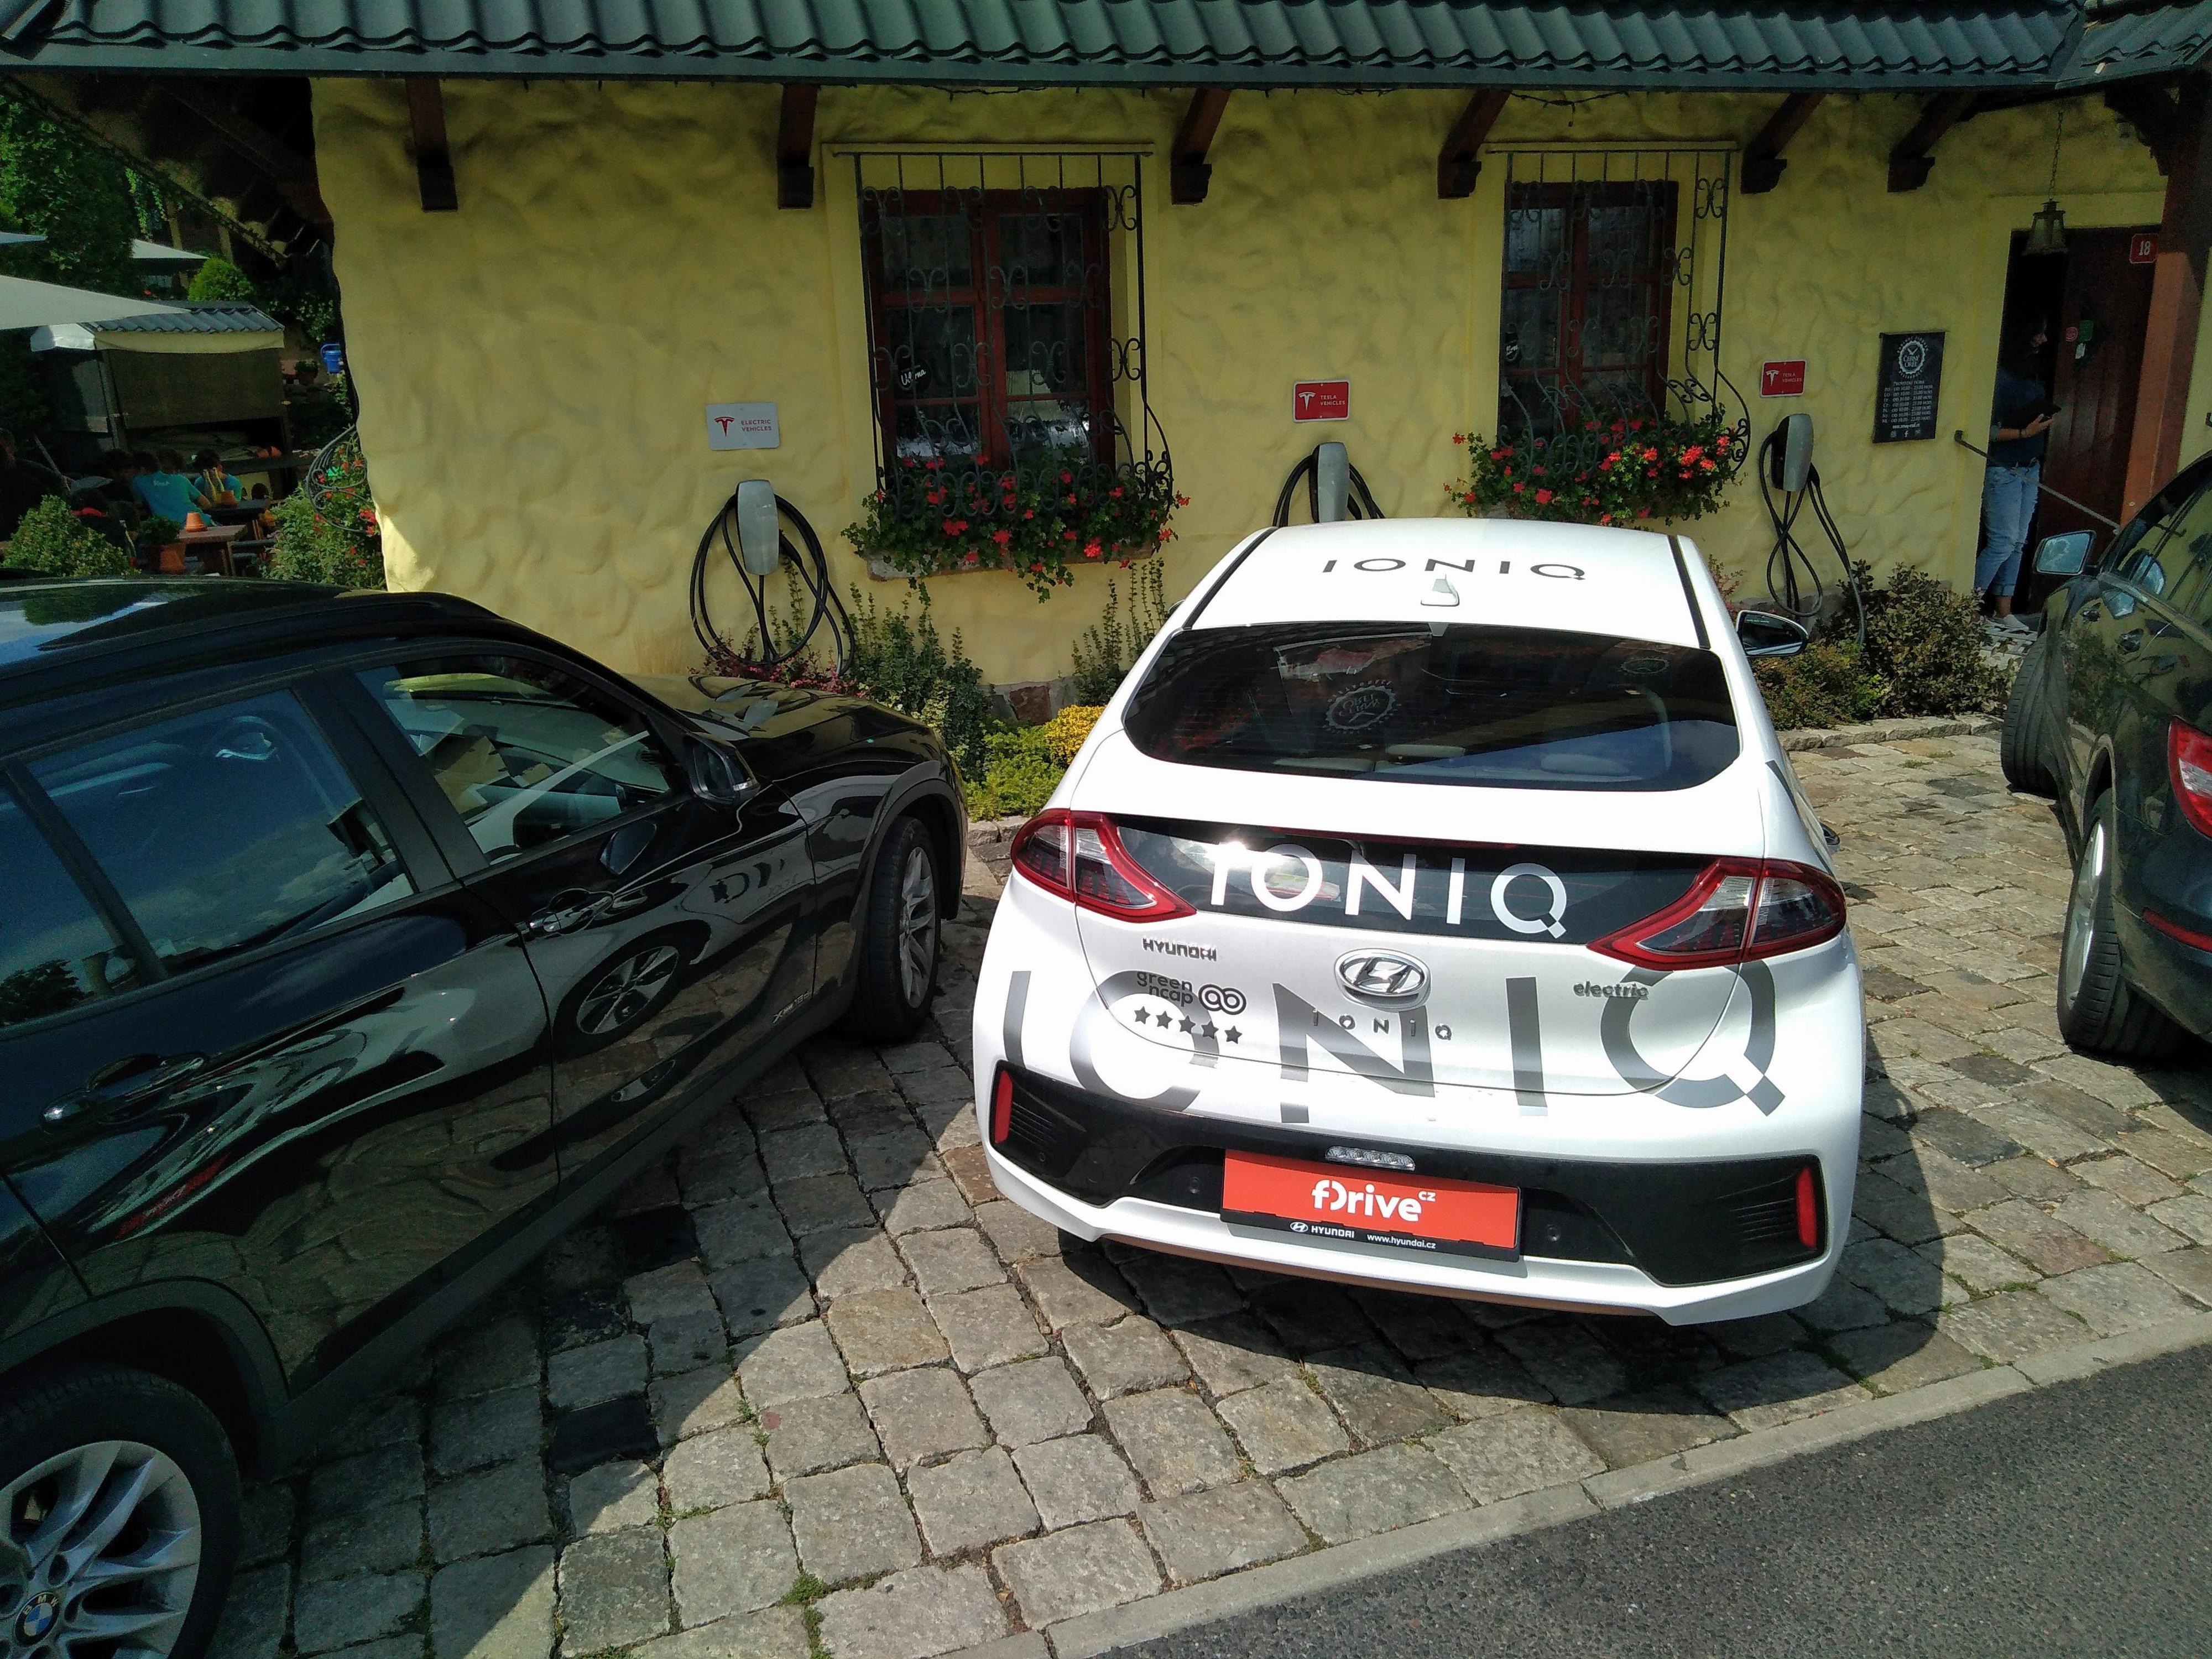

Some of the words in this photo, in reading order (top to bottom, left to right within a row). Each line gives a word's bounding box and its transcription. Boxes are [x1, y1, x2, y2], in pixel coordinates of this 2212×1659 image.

[2139, 241, 2151, 255] 18
[1322, 558, 1585, 580] IONIQ
[1211, 842, 1568, 939] IONIQ
[1142, 936, 1217, 962] HYUNDAI
[1136, 971, 1193, 993] green
[1573, 980, 1650, 999] electric
[1149, 984, 1193, 1007] ncap
[1312, 1008, 1452, 1041] IONIQ
[1003, 960, 1786, 1123] IONIQ
[1311, 1179, 1422, 1222] fDrive
[1311, 1225, 1355, 1238] HYUNDAI
[1367, 1233, 1437, 1249] www.hyundai.cz
[23, 1594, 59, 1615] BMW
